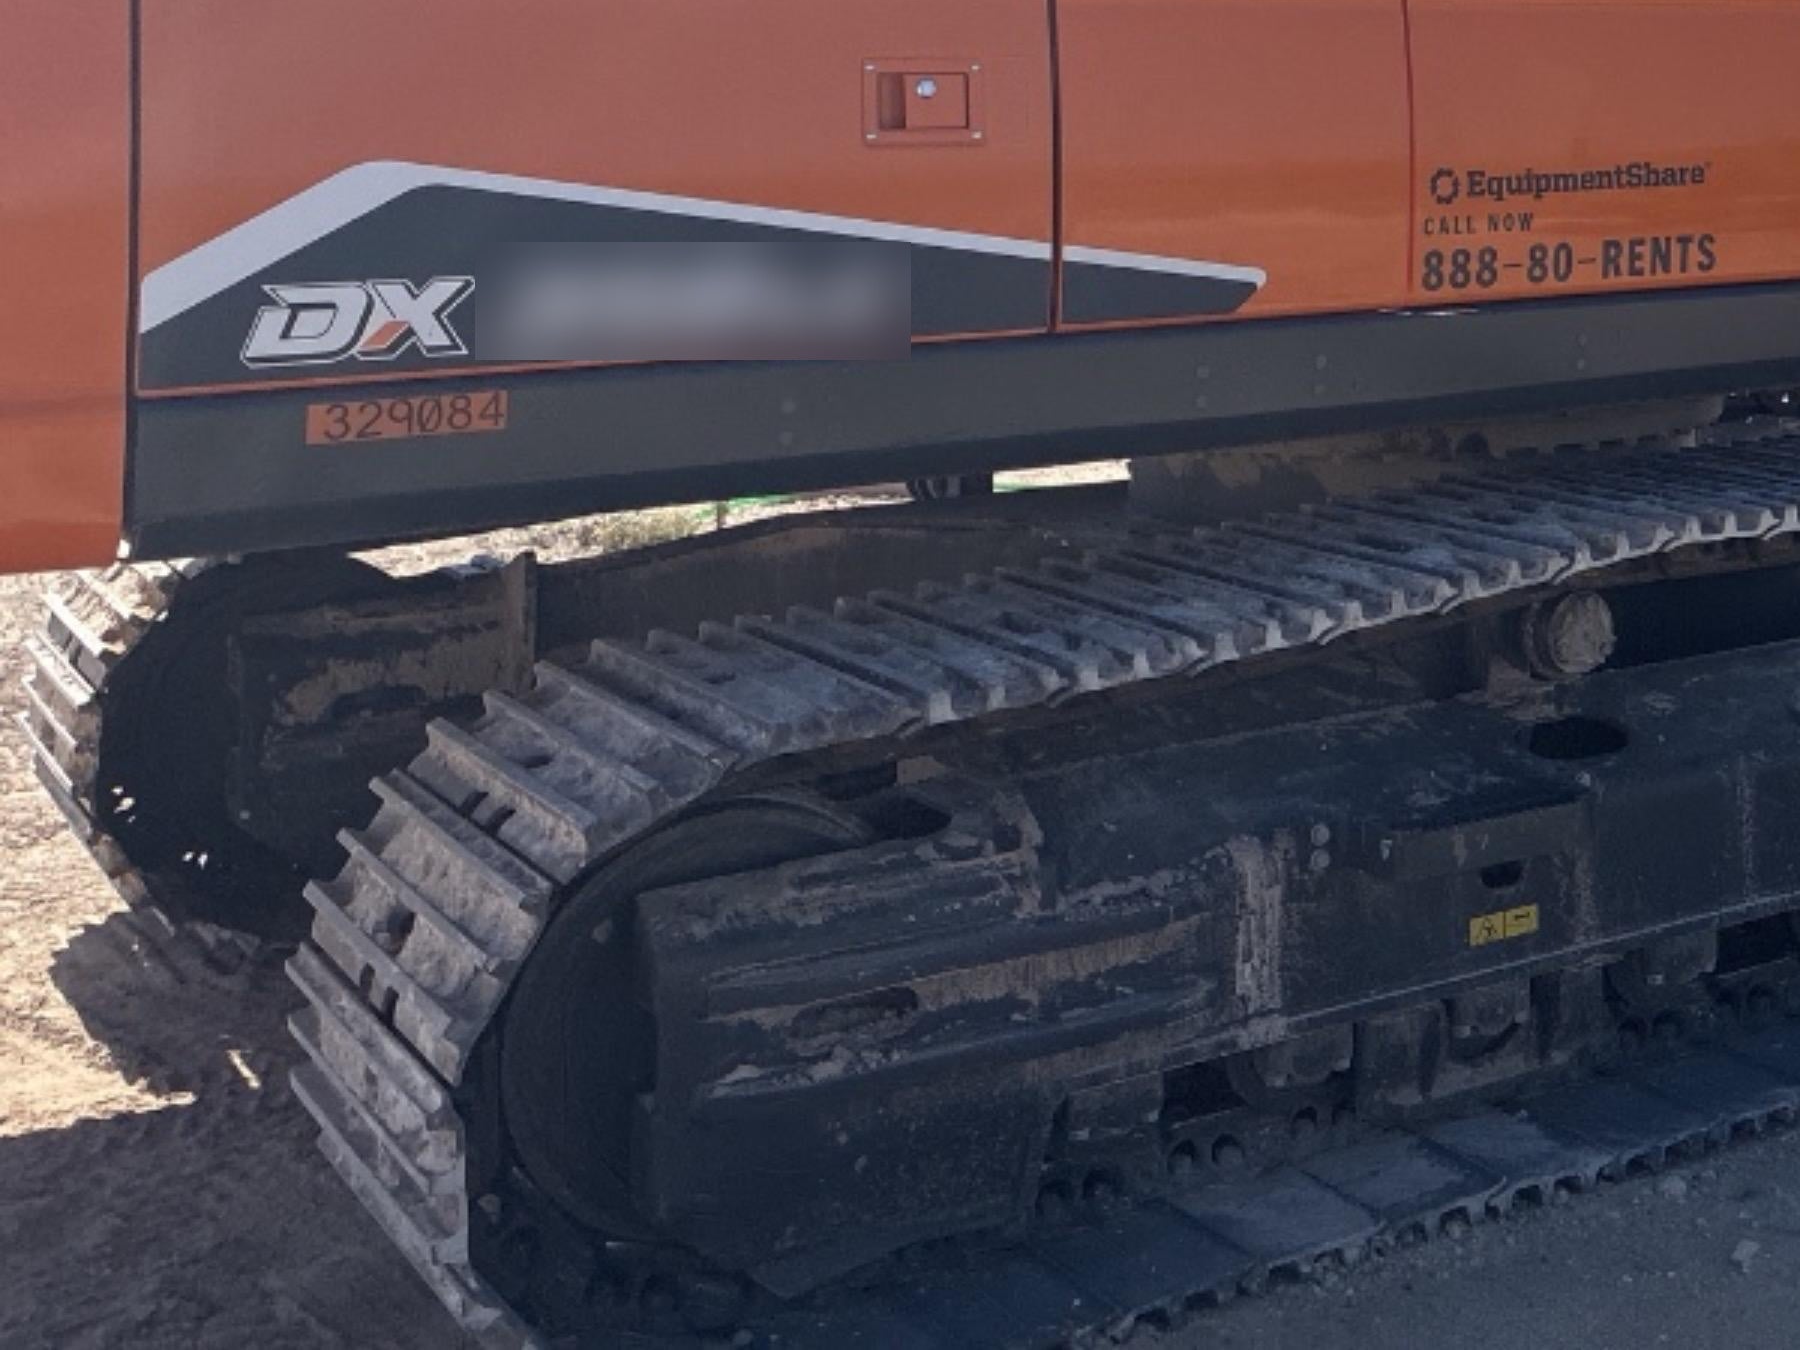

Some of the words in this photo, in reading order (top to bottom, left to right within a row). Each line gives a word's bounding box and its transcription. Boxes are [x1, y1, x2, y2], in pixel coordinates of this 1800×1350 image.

[1465, 161, 1706, 200] EquipmentShare
[1423, 214, 1477, 236] CALL
[1486, 211, 1535, 233] NOW
[1421, 233, 1718, 292] 888-80-RENTS
[240, 275, 475, 369] DX
[323, 393, 505, 440] 329084
